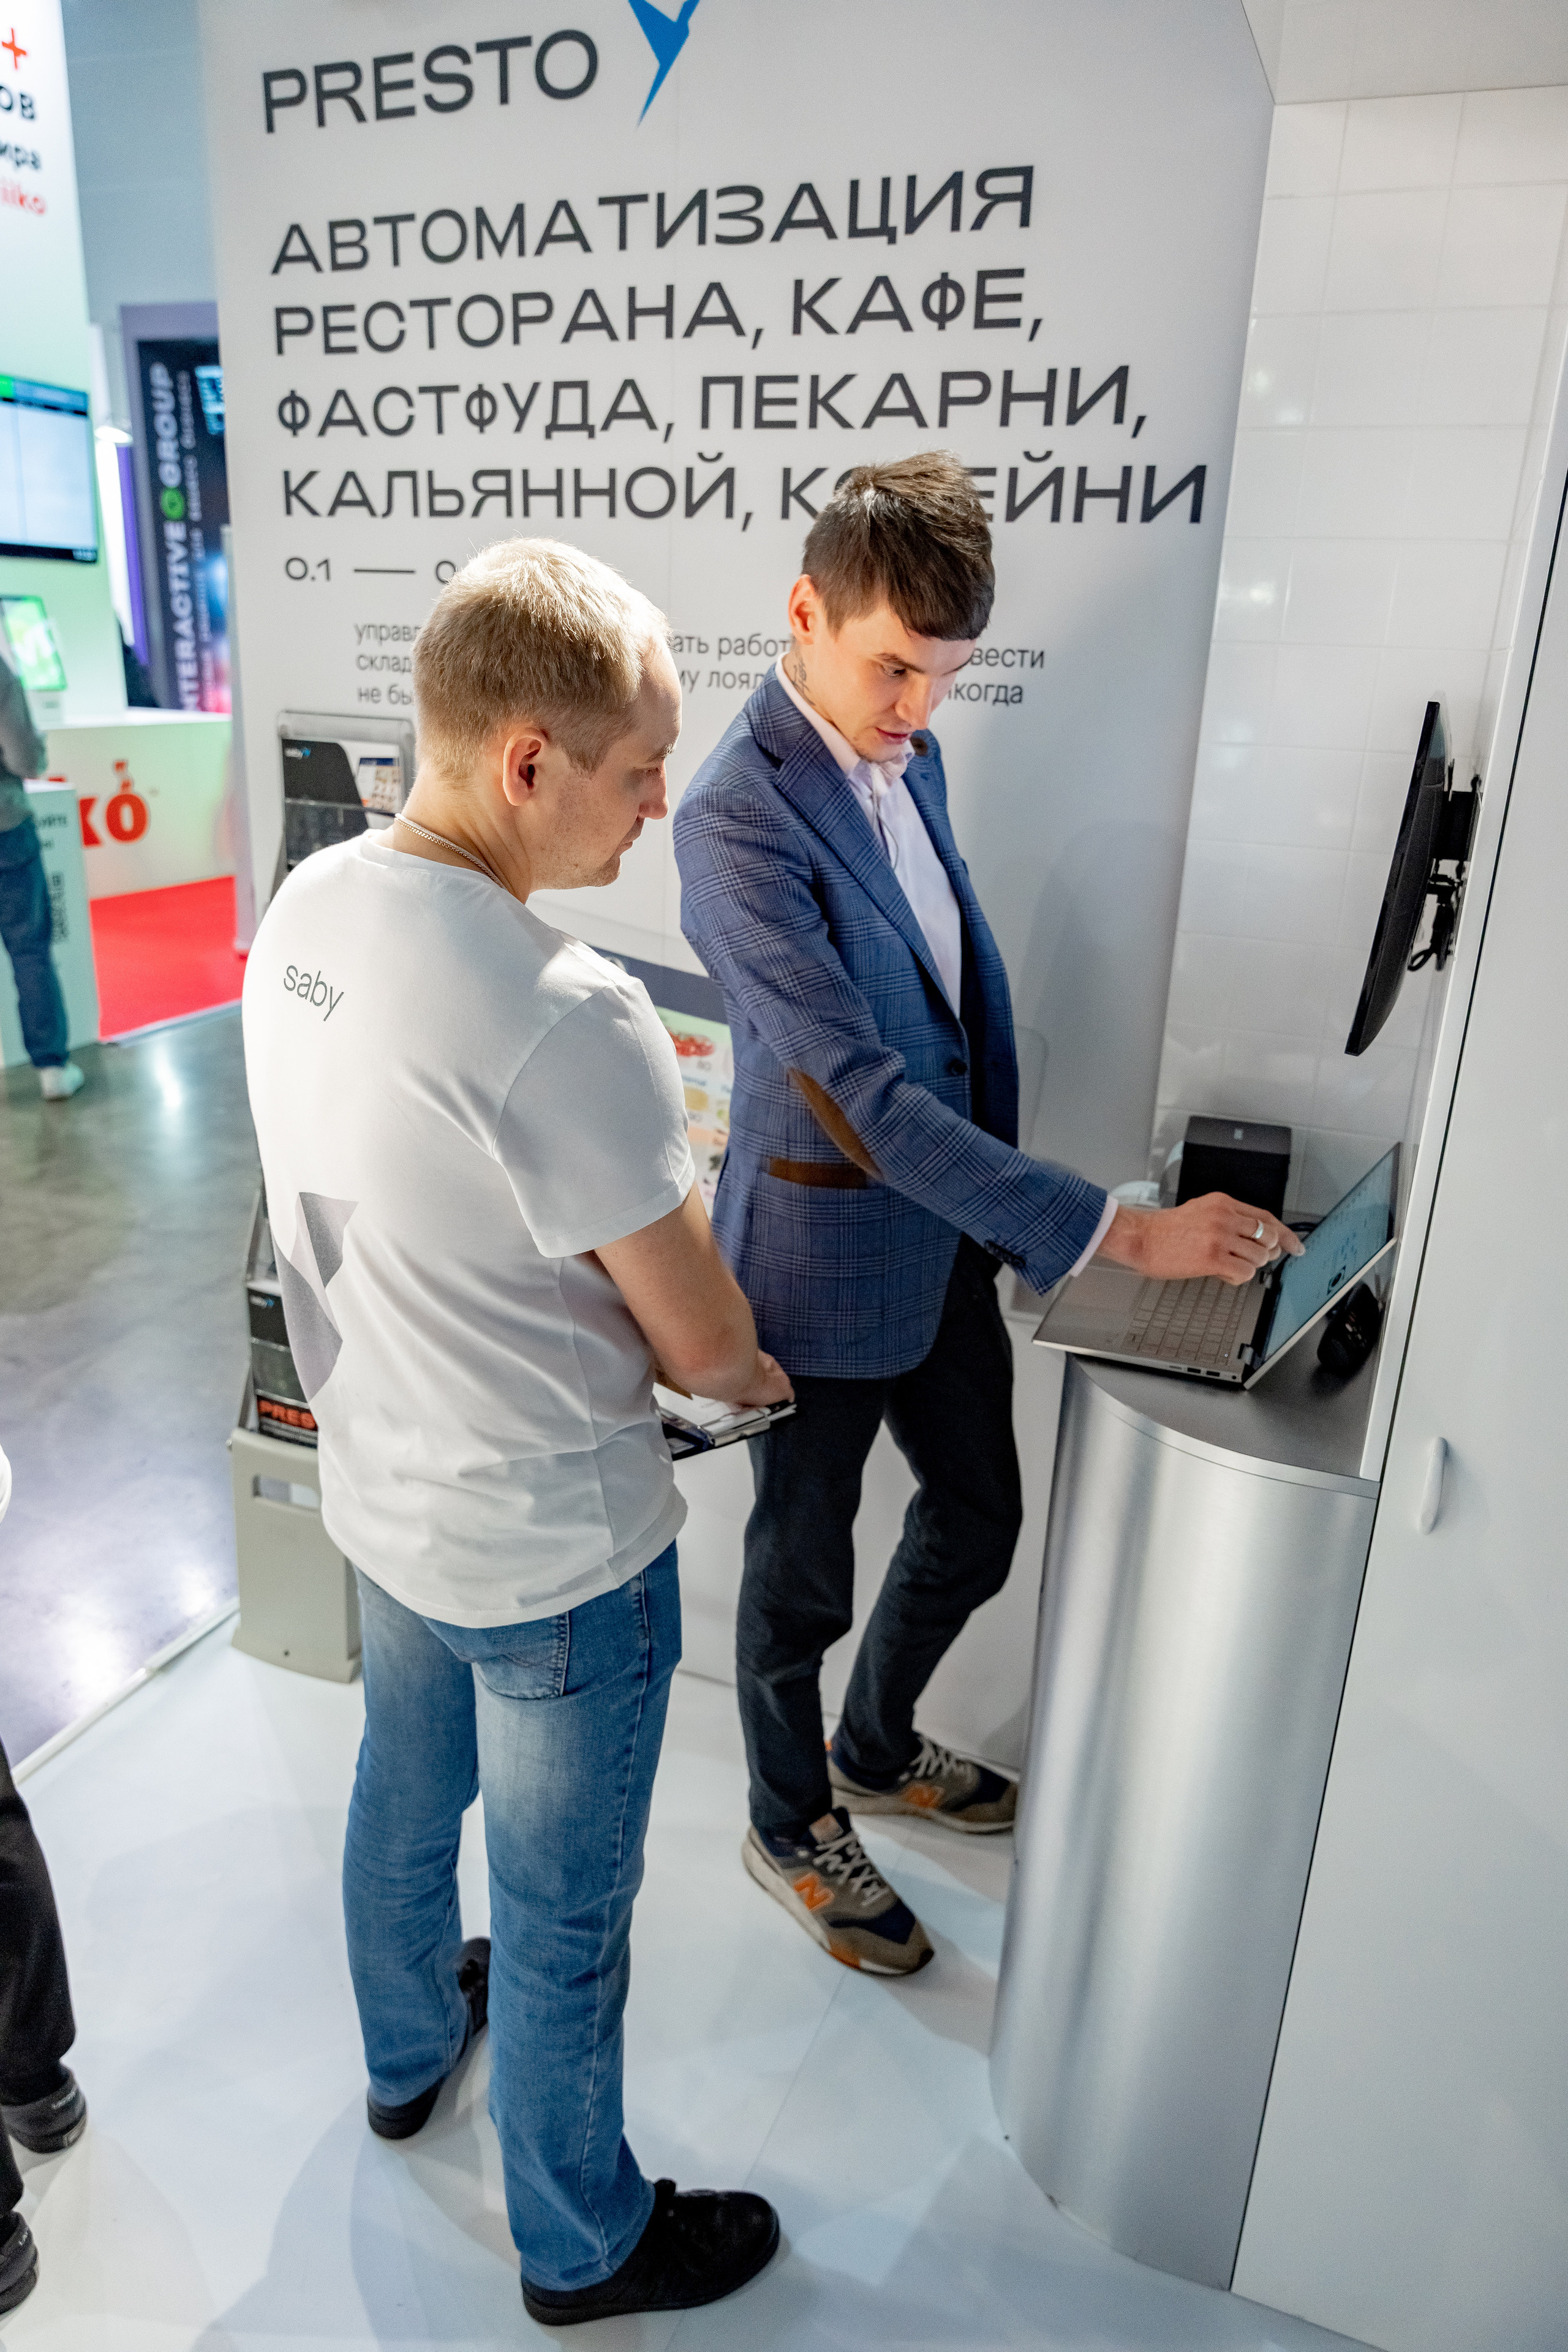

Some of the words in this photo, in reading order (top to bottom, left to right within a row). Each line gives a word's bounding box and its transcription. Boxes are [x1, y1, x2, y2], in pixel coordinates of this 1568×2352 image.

[262, 28, 599, 134] PRESTO
[270, 164, 1035, 276] АВТОМАТИЗАЦИЯ
[274, 281, 764, 356] РЕСТОРАНА,
[791, 267, 1043, 343] КАФЕ,
[149, 361, 182, 488] GROUP
[277, 378, 675, 444] ФАСТФУДА,
[700, 364, 1147, 440] ПЕКАРНИ,
[282, 451, 753, 533] КАЛЬЯННОЙ,
[781, 450, 1208, 528] КЕЙНИ
[435, 560, 457, 585] 0
[356, 654, 412, 674] склад
[948, 682, 1023, 706] когда
[673, 635, 709, 654] ать
[718, 633, 790, 662] работ
[356, 686, 381, 704] не
[284, 965, 344, 1022] saby
[257, 1399, 318, 1431] PRES
